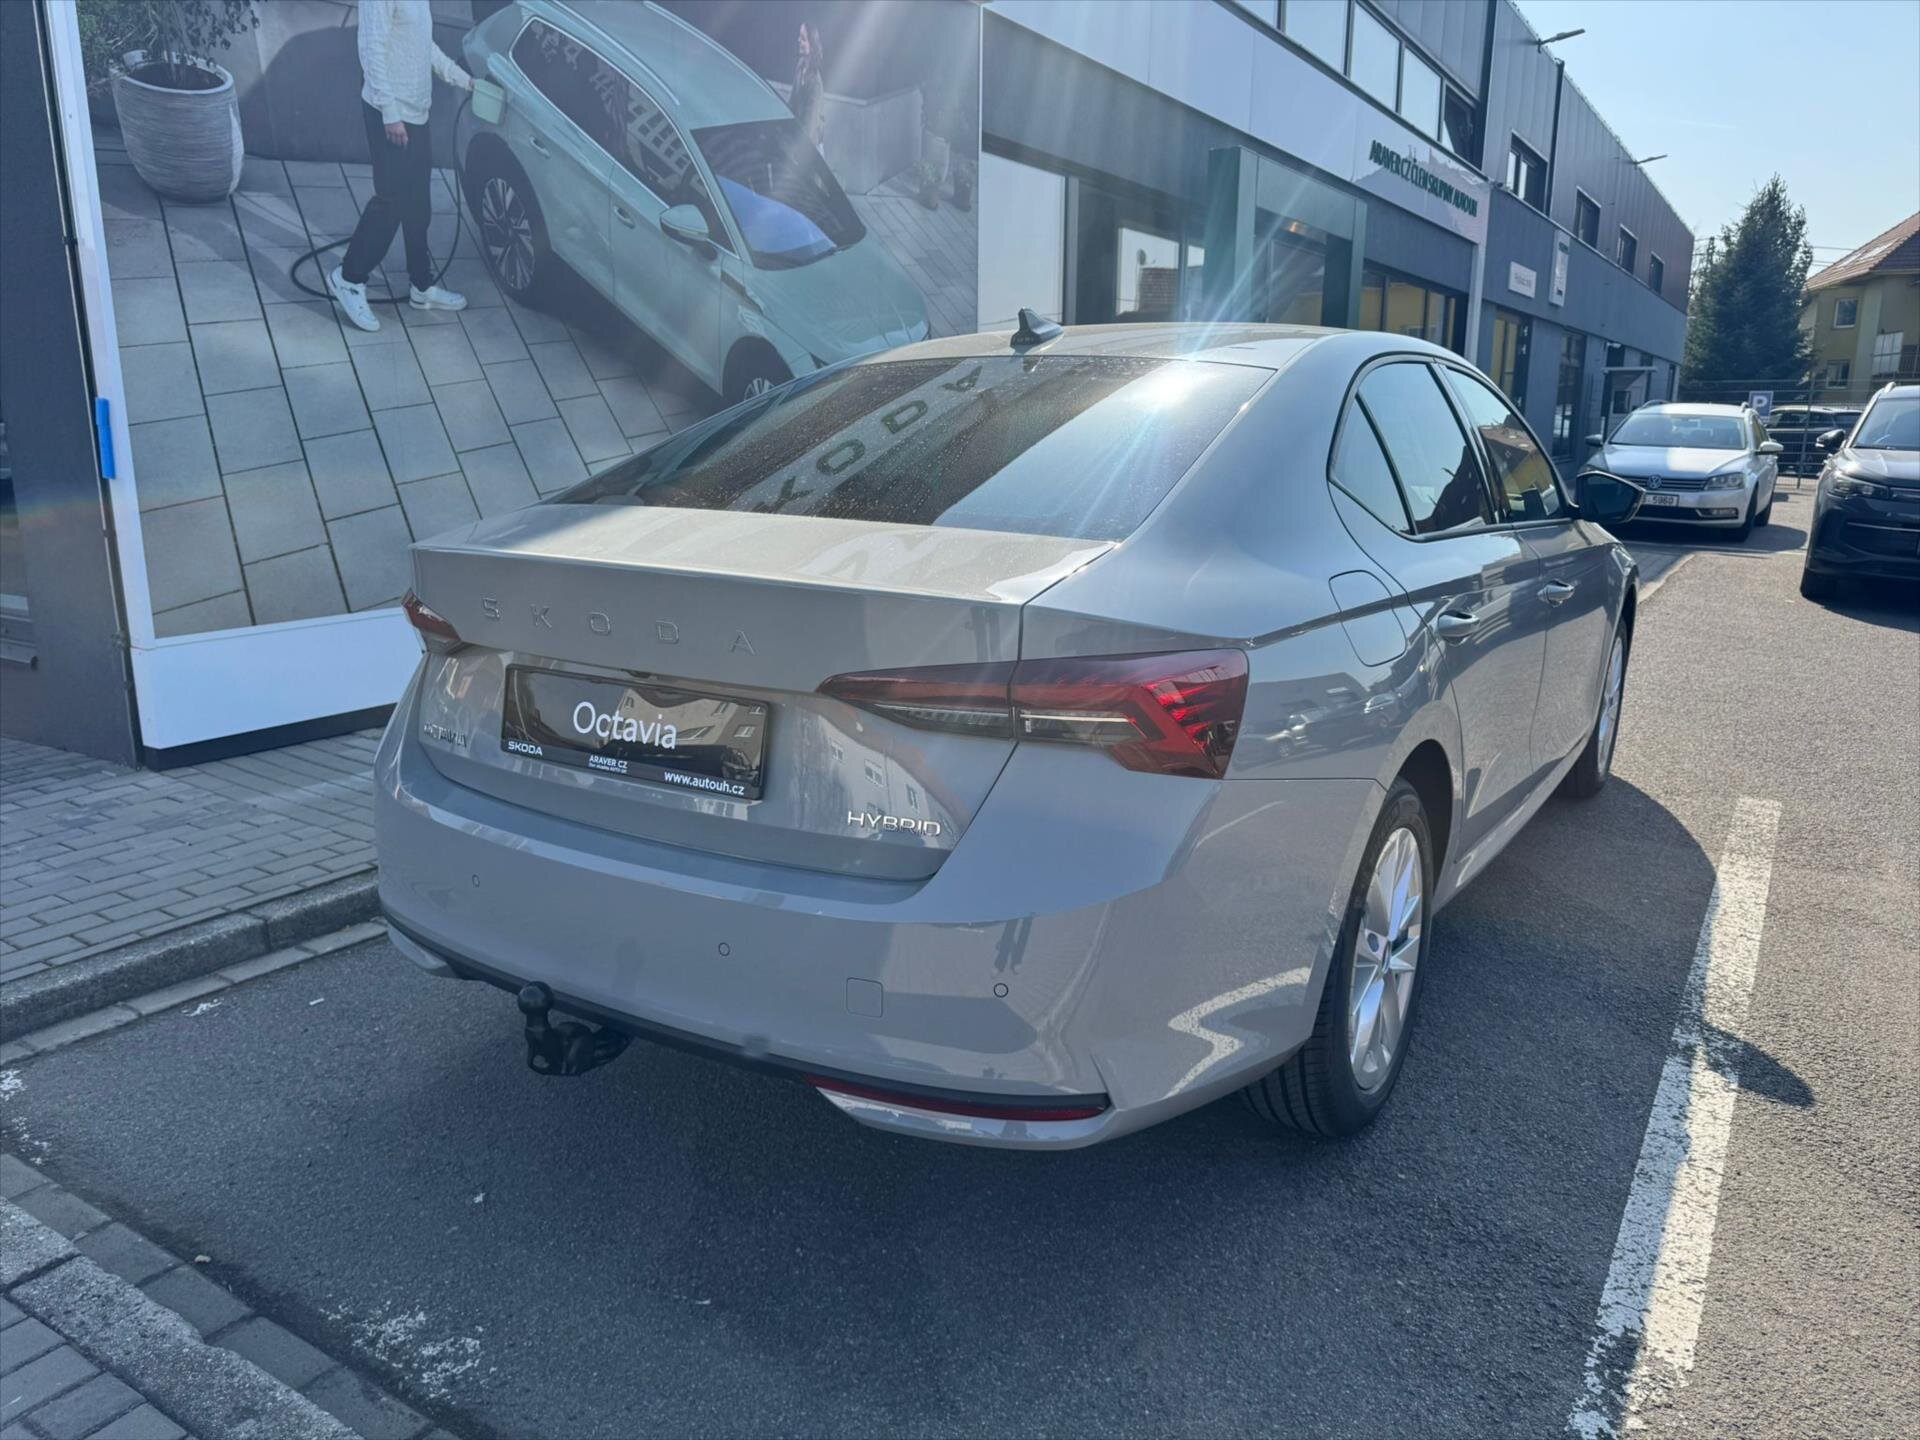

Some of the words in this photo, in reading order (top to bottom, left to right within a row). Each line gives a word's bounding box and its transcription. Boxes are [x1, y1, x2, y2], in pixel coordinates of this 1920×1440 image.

[1752, 395, 1768, 410] P
[573, 701, 677, 749] Octavia
[588, 754, 617, 768] ARAVER
[618, 760, 628, 769] CZ
[664, 771, 745, 796] www.autouh.cz
[847, 810, 941, 837] HYBRID
